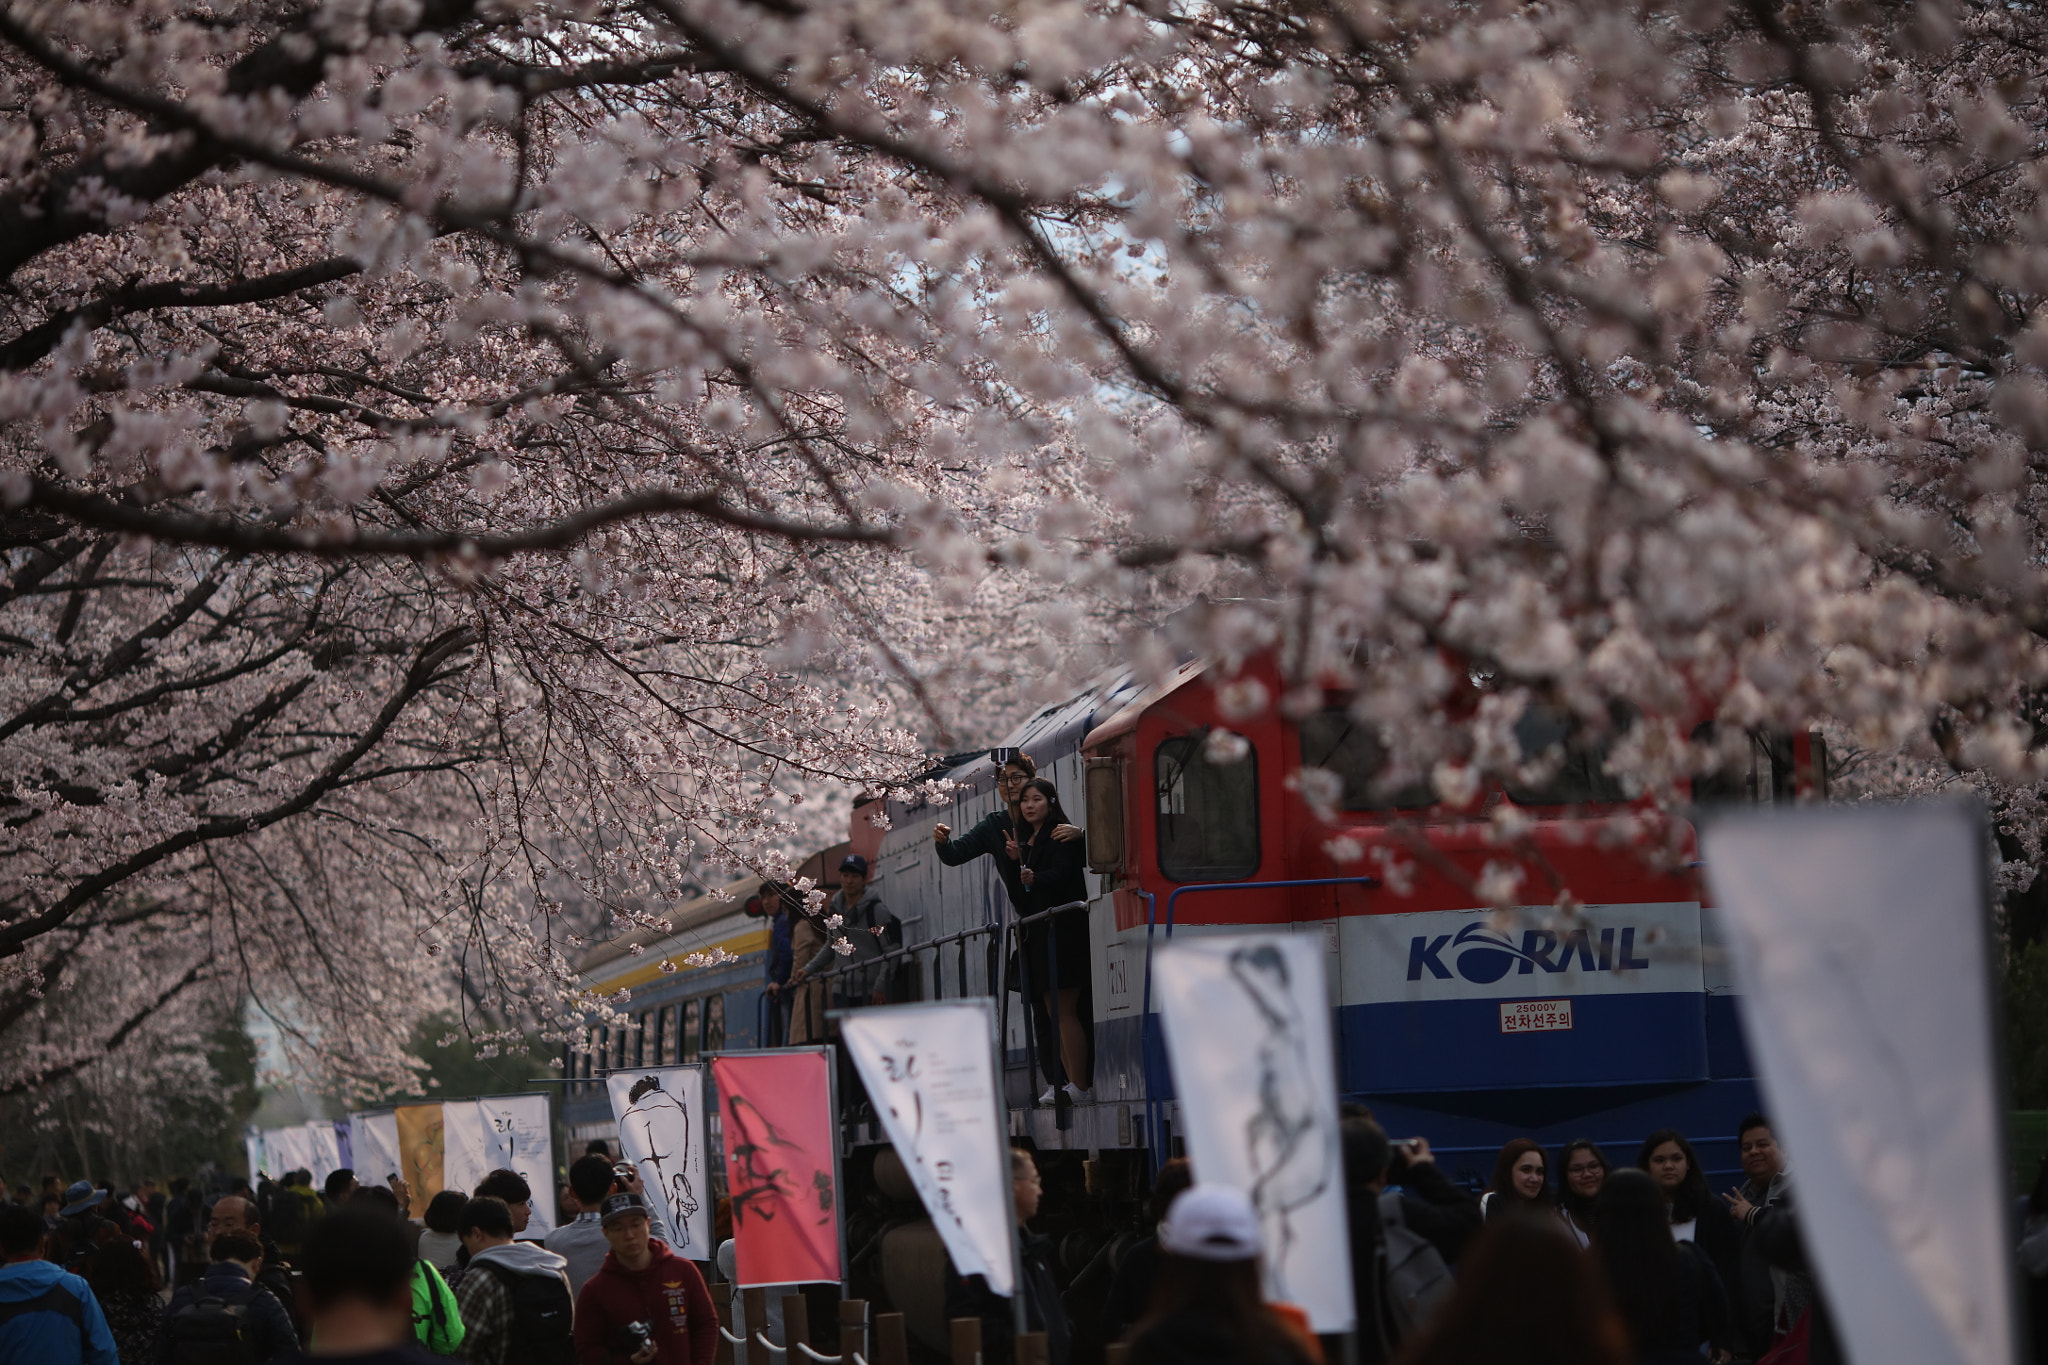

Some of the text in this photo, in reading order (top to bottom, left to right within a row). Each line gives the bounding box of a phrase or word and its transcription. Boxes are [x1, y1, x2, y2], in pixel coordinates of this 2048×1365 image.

[1407, 921, 1649, 984] KORAIL
[1516, 1003, 1557, 1013] 25000V
[1504, 1012, 1570, 1030] 전차선주의
